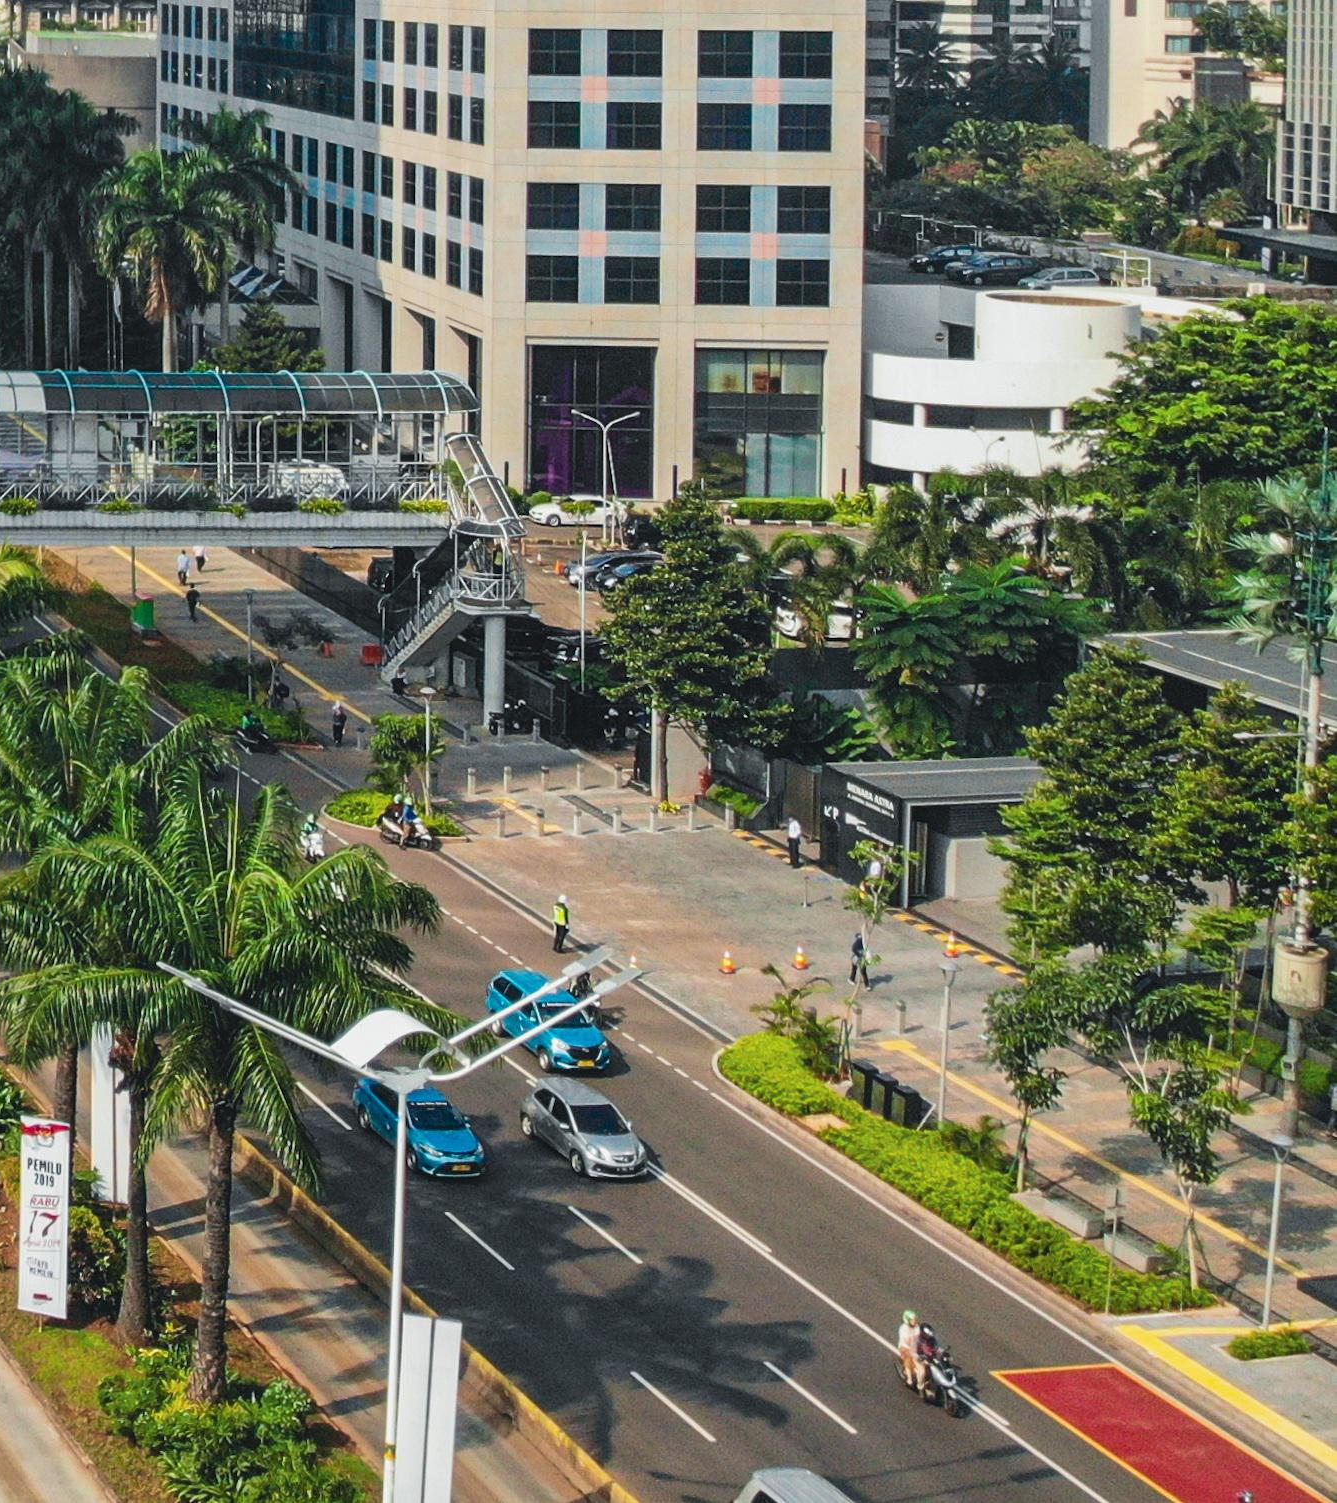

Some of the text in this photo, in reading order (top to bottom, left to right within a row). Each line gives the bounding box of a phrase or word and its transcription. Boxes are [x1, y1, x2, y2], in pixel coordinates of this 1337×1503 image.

[847, 782, 873, 802] MENARA
[874, 795, 894, 812] ASTRA
[833, 807, 839, 820] P
[27, 1157, 62, 1175] PEMILU
[34, 1173, 54, 1188] 2019
[30, 1197, 59, 1207] RABU
[29, 1210, 61, 1237] 17
